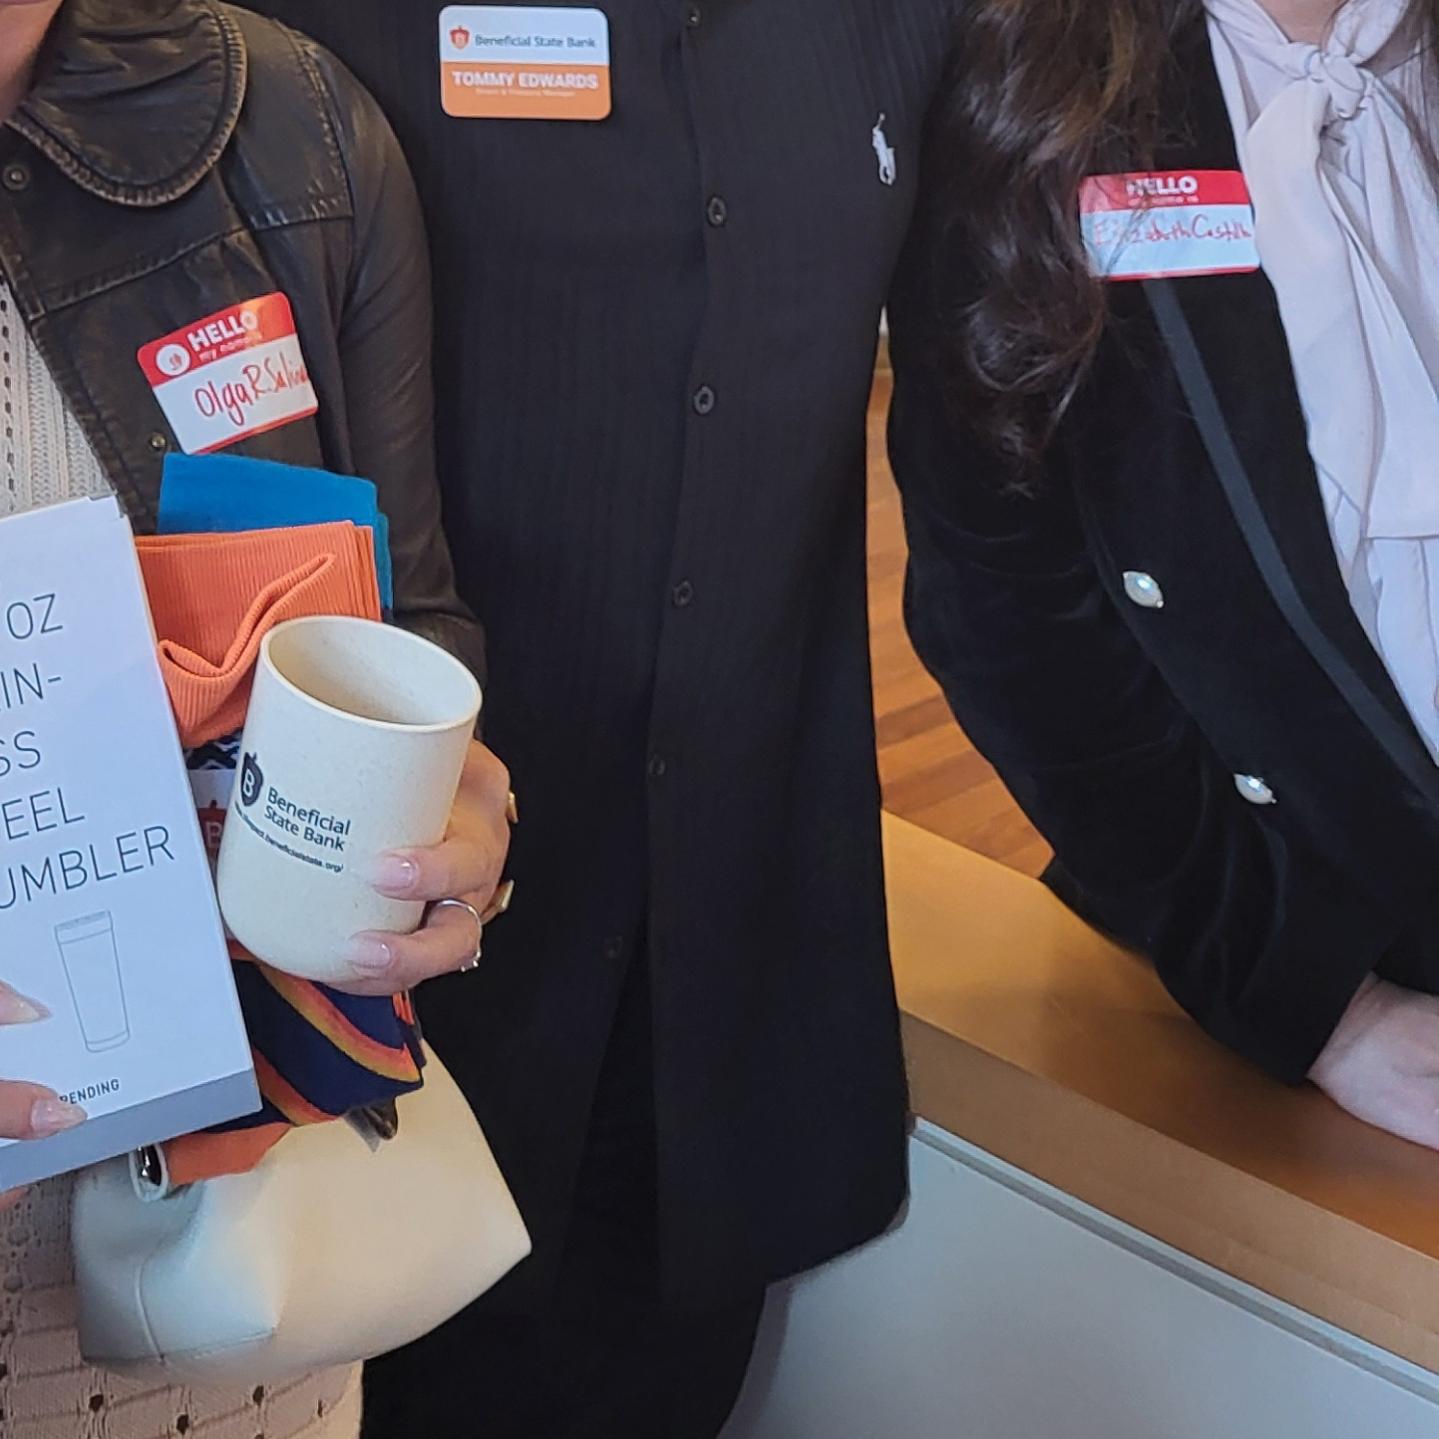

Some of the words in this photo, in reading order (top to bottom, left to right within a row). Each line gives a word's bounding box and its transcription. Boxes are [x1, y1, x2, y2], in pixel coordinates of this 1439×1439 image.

[475, 34, 531, 47] Beneficial
[534, 36, 563, 47] State
[566, 37, 596, 48] Bank
[451, 70, 515, 87] TOMMY
[518, 72, 599, 89] EDWARDS
[186, 310, 259, 352] HELLO
[194, 380, 254, 427] Olga
[6, 592, 63, 640] OZ
[264, 804, 300, 837] State
[303, 826, 346, 852] Bank
[267, 786, 351, 836] Beneficial
